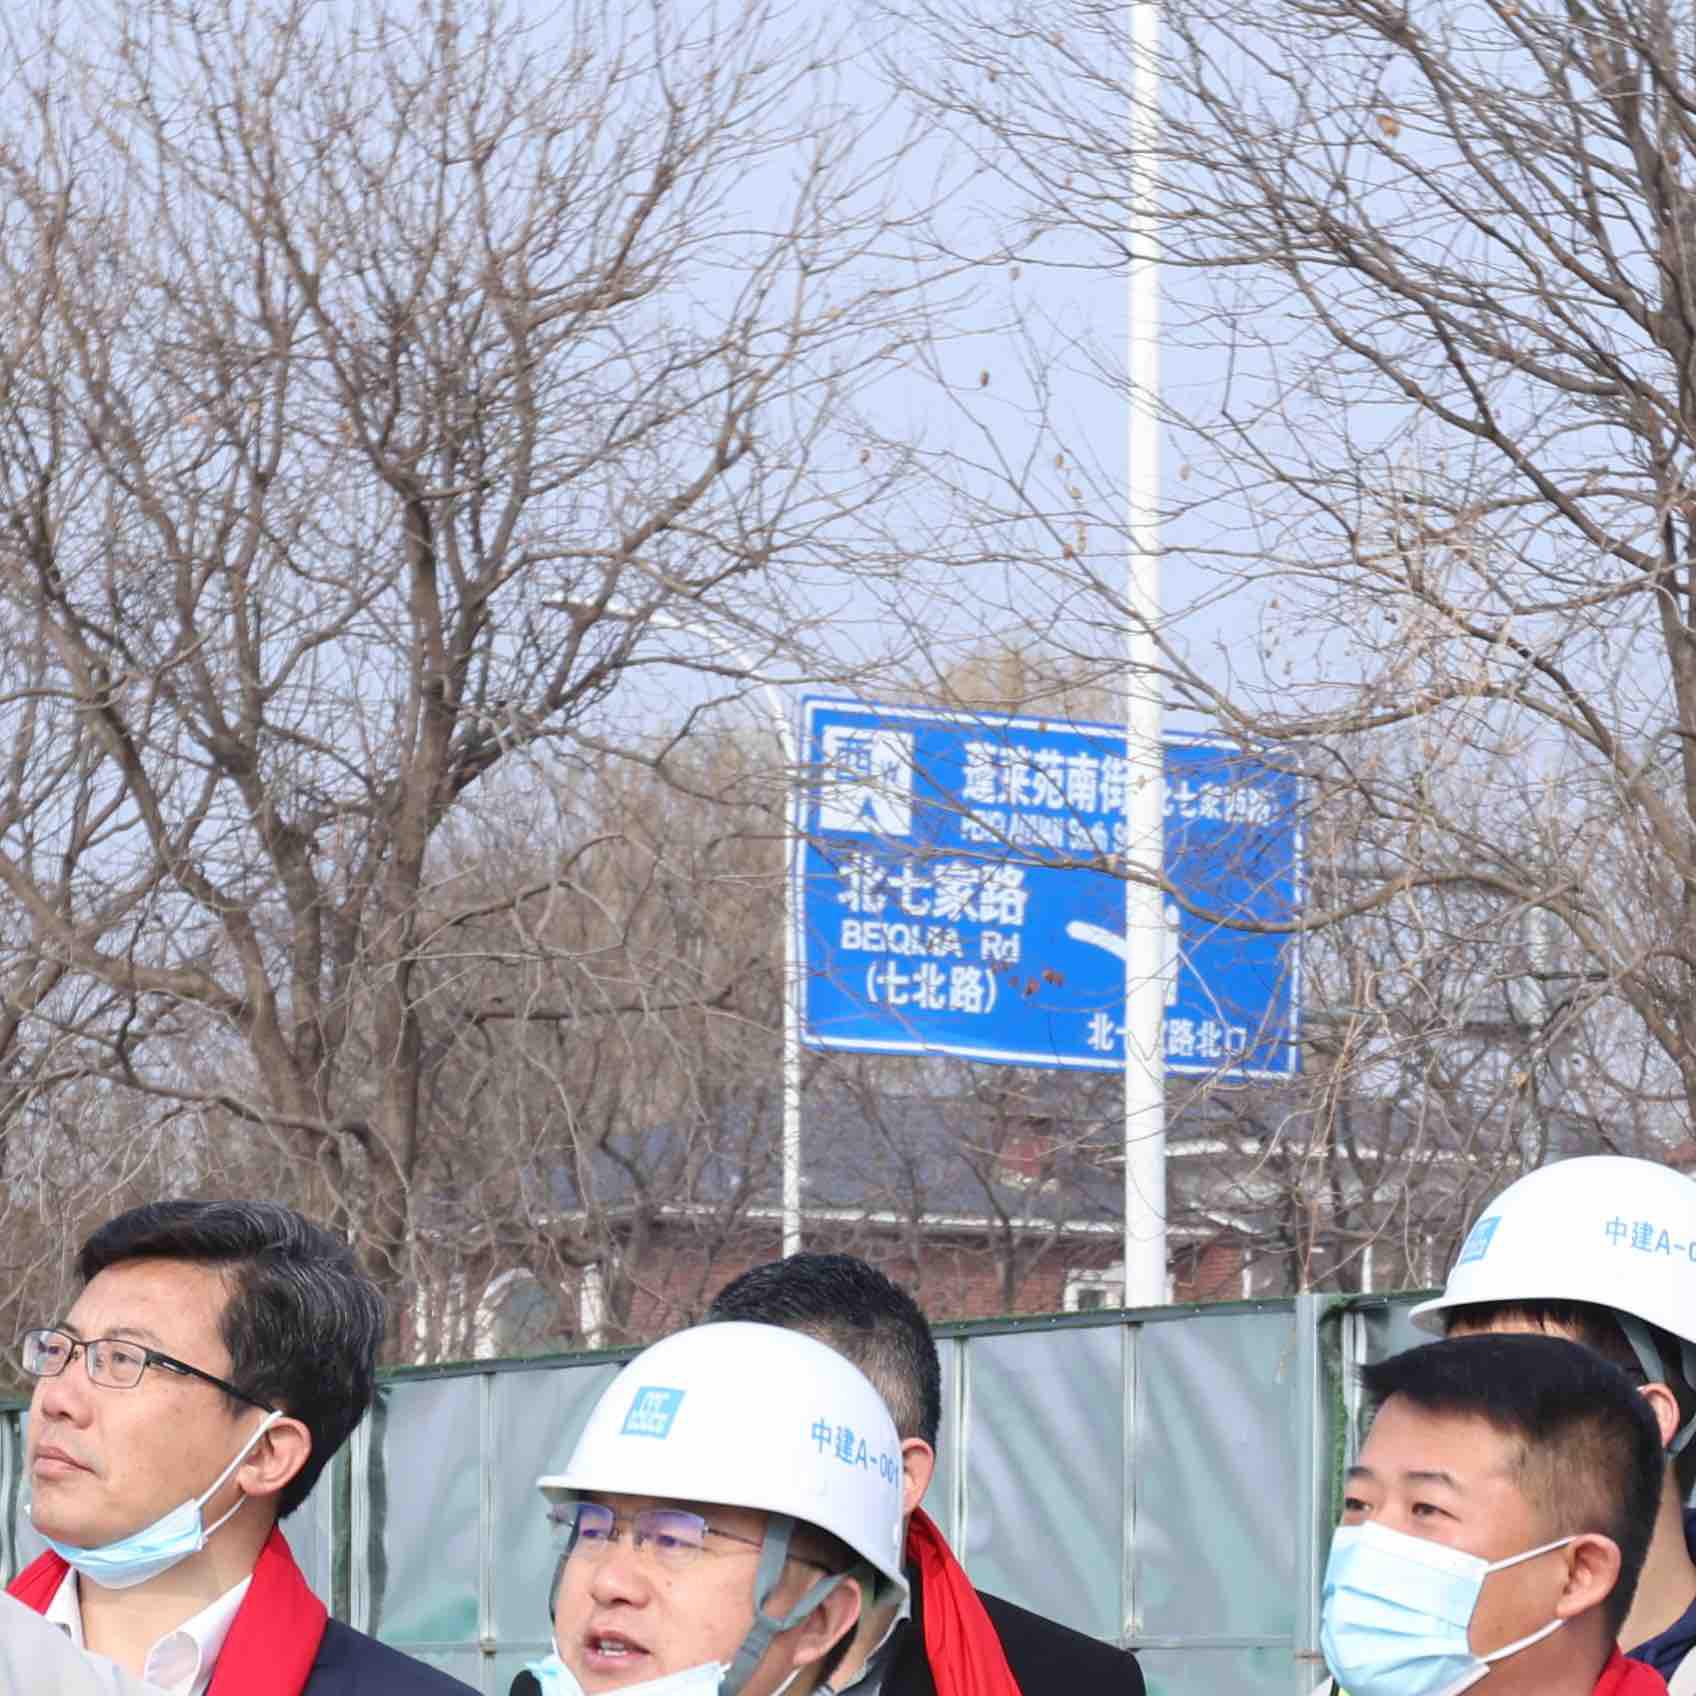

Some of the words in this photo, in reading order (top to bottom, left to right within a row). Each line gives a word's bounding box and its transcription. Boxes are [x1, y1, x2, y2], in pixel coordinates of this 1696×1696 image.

[837, 853, 1029, 925] 北七家路
[980, 930, 1022, 964] Rd
[1087, 1013, 1247, 1058] 北路北口
